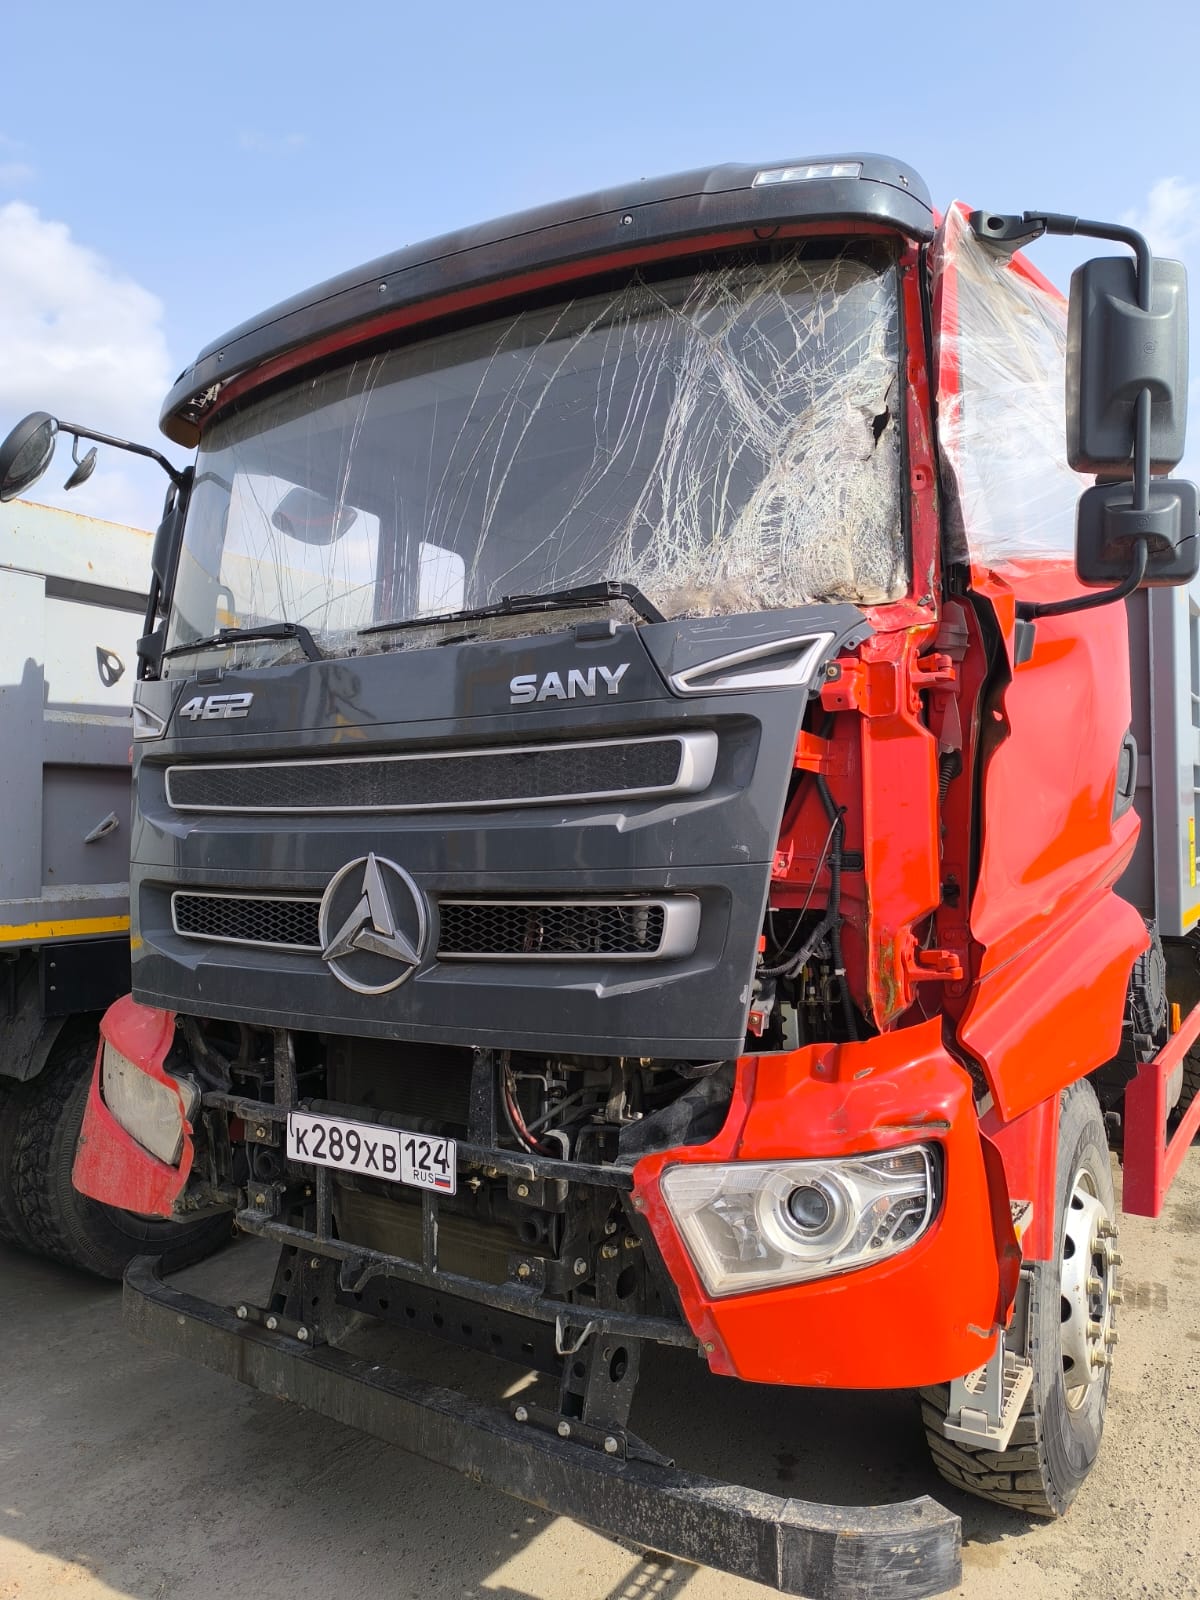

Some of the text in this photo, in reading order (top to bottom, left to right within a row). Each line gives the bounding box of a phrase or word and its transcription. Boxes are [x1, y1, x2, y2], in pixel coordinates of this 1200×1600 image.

[509, 663, 631, 705] SANY
[179, 692, 254, 721] 462
[404, 1138, 448, 1174] 124
[413, 1170, 434, 1184] RUS
